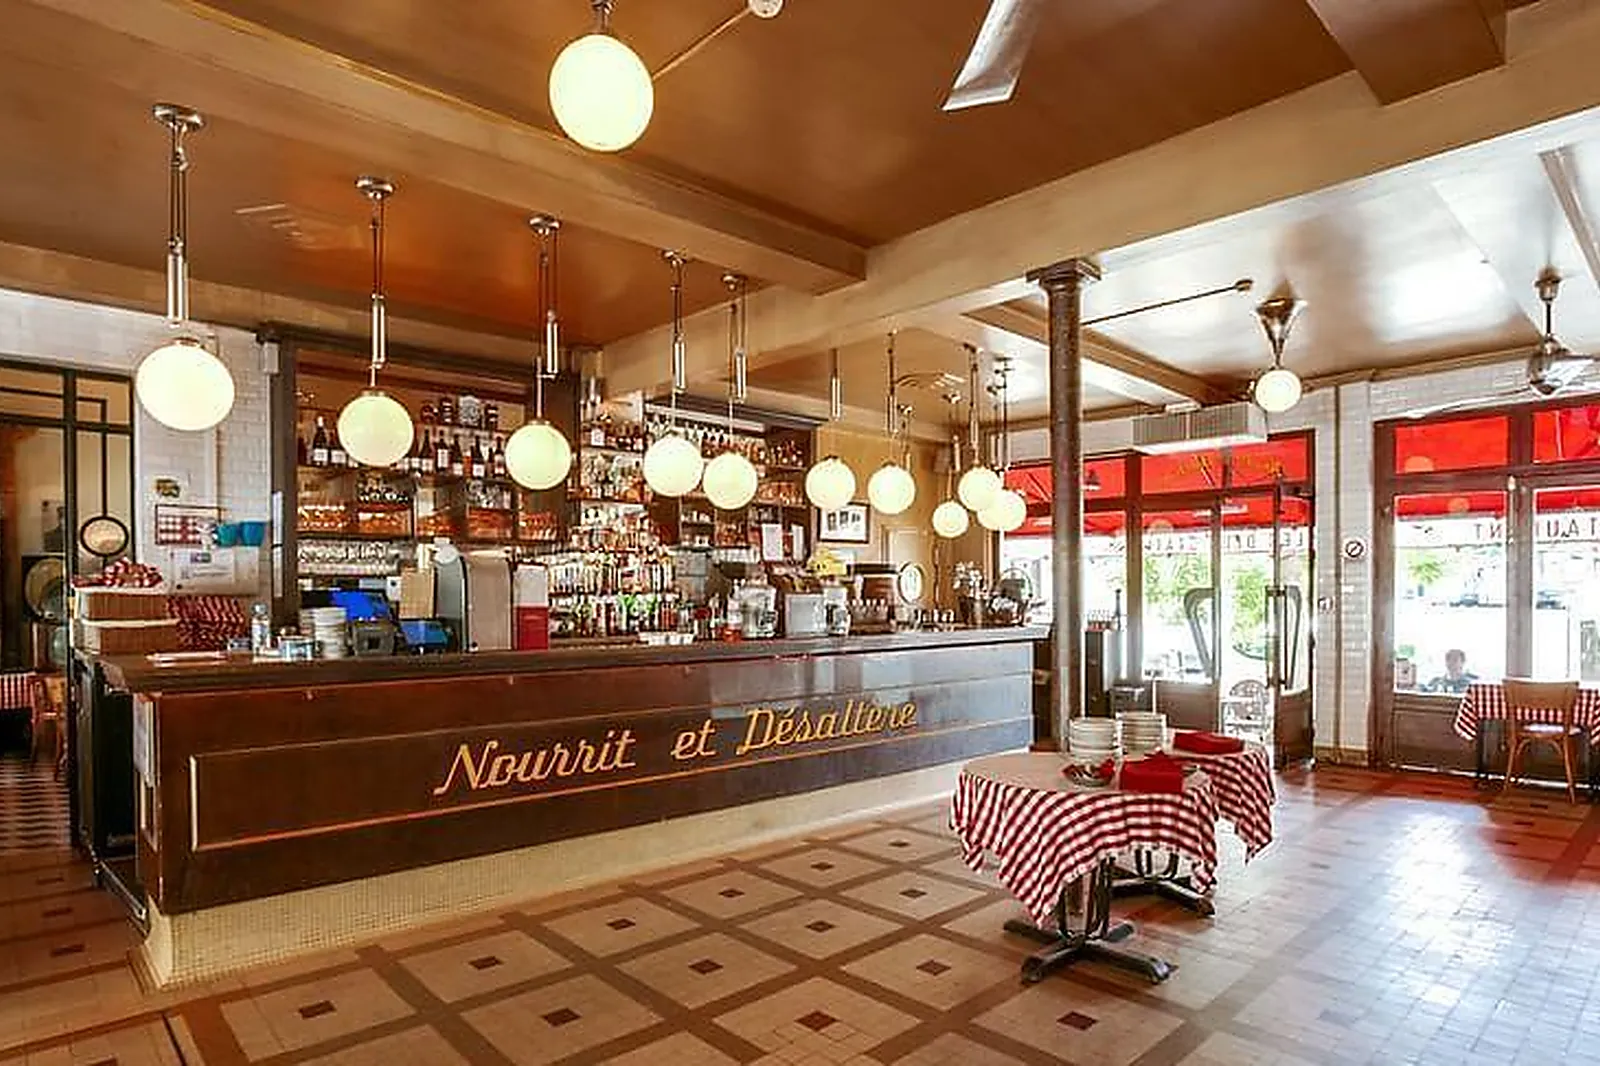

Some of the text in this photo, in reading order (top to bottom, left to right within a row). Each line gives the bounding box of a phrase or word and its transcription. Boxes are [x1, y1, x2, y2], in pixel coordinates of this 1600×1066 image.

[433, 696, 917, 795] Nourrit et Désaltère
